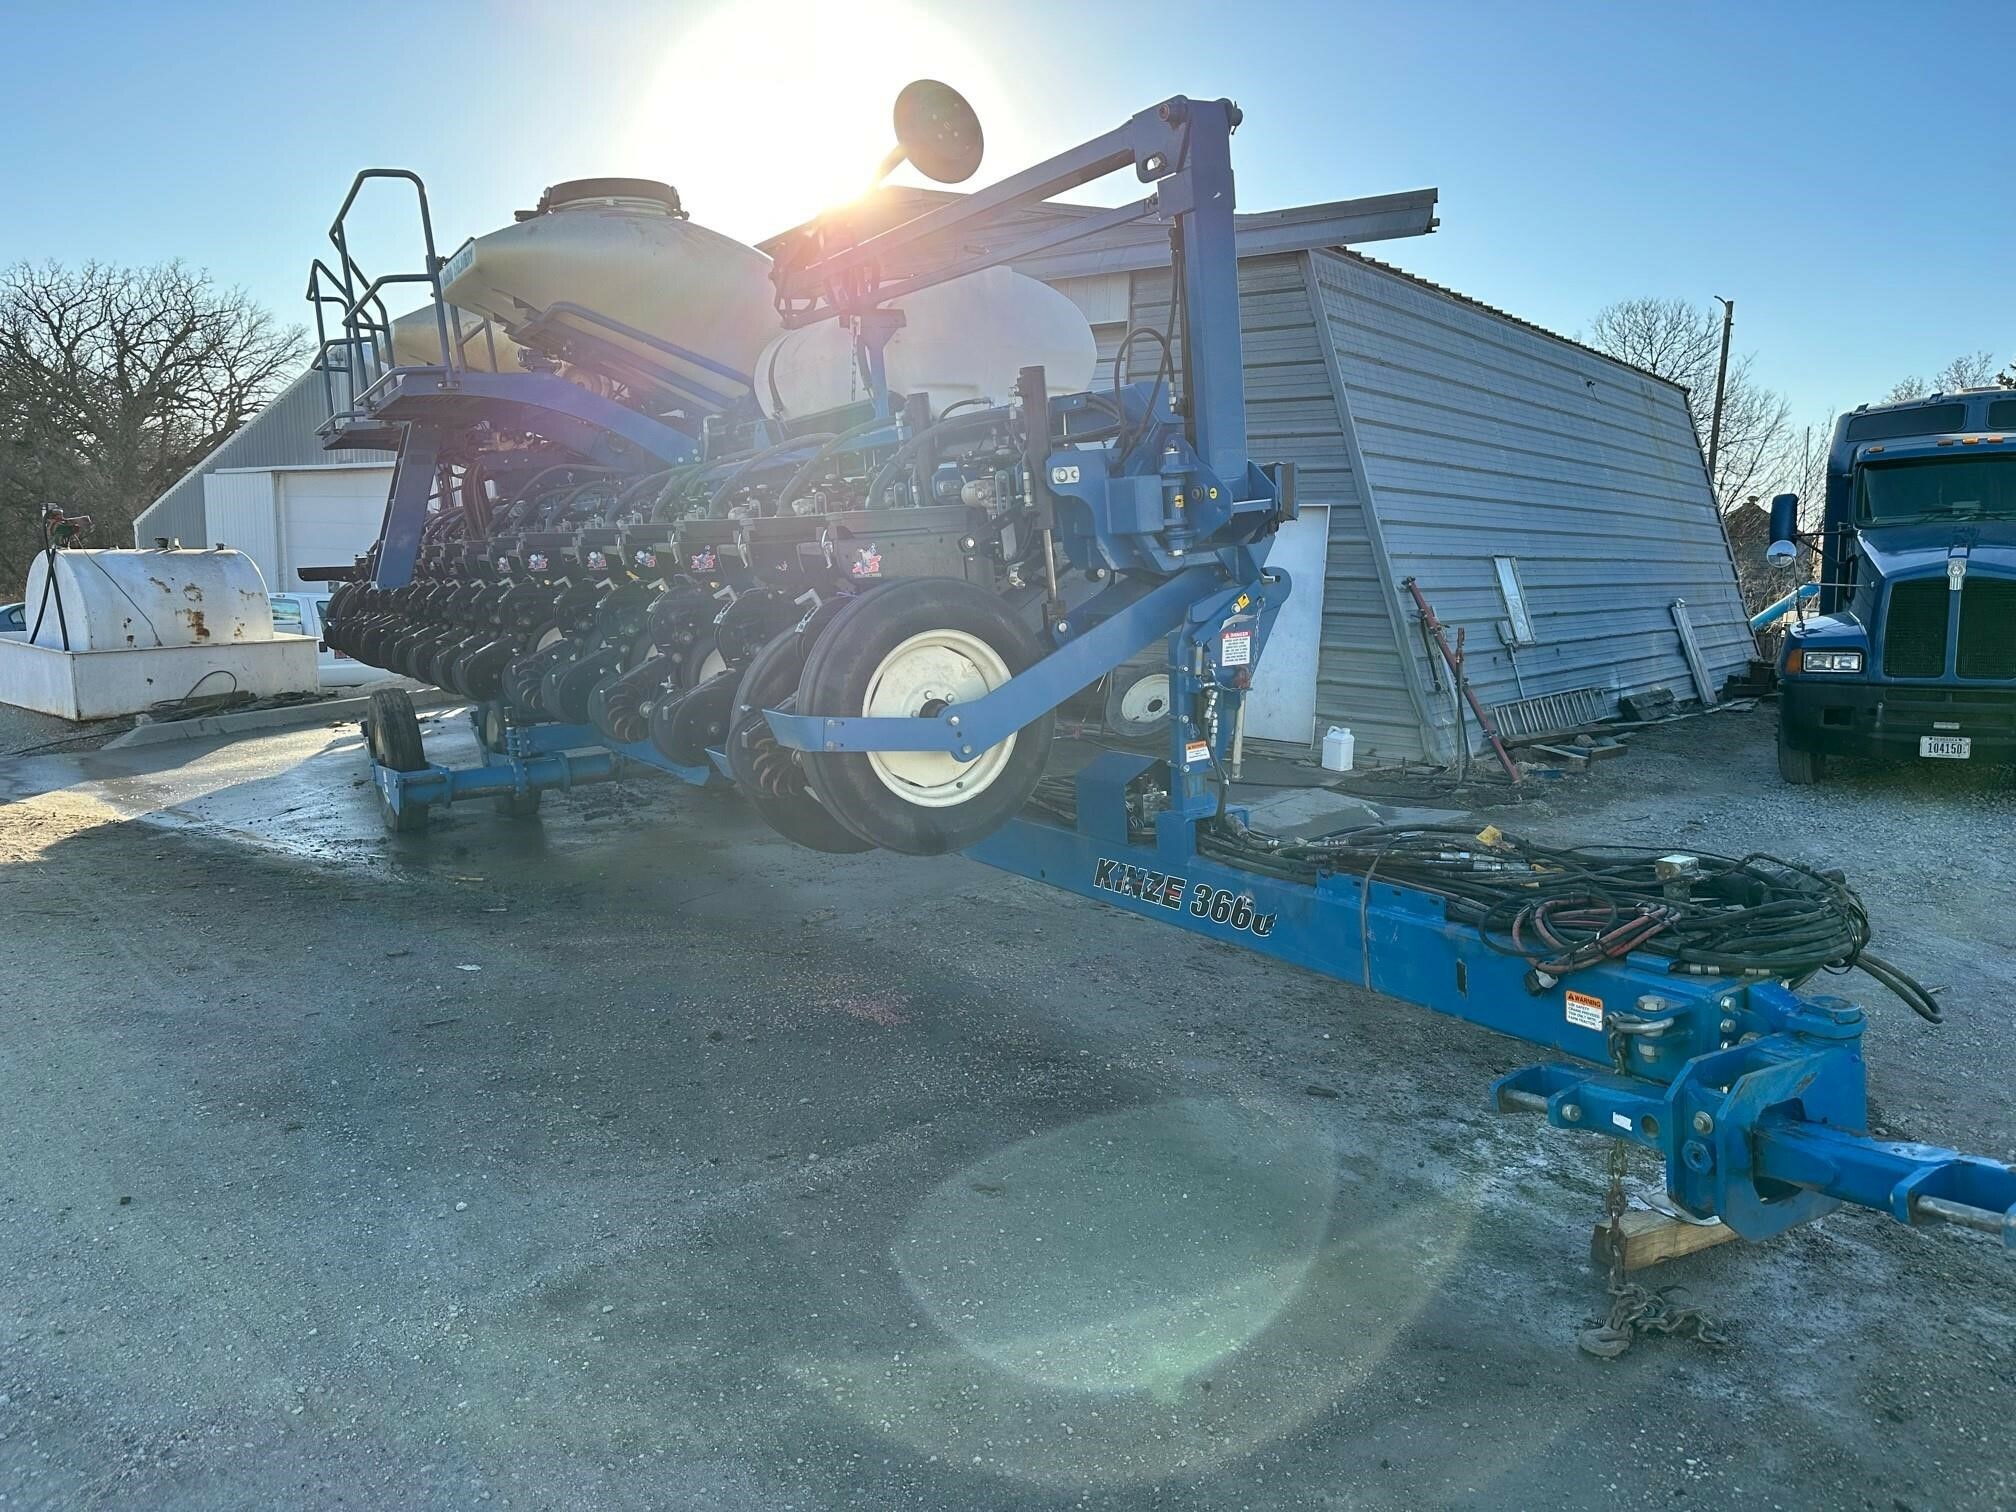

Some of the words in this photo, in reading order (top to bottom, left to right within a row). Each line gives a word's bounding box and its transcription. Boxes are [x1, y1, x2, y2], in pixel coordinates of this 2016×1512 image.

[1928, 742, 1962, 754] 104150
[1093, 857, 1188, 911] KINZE
[1574, 995, 1601, 1007] WARNING
